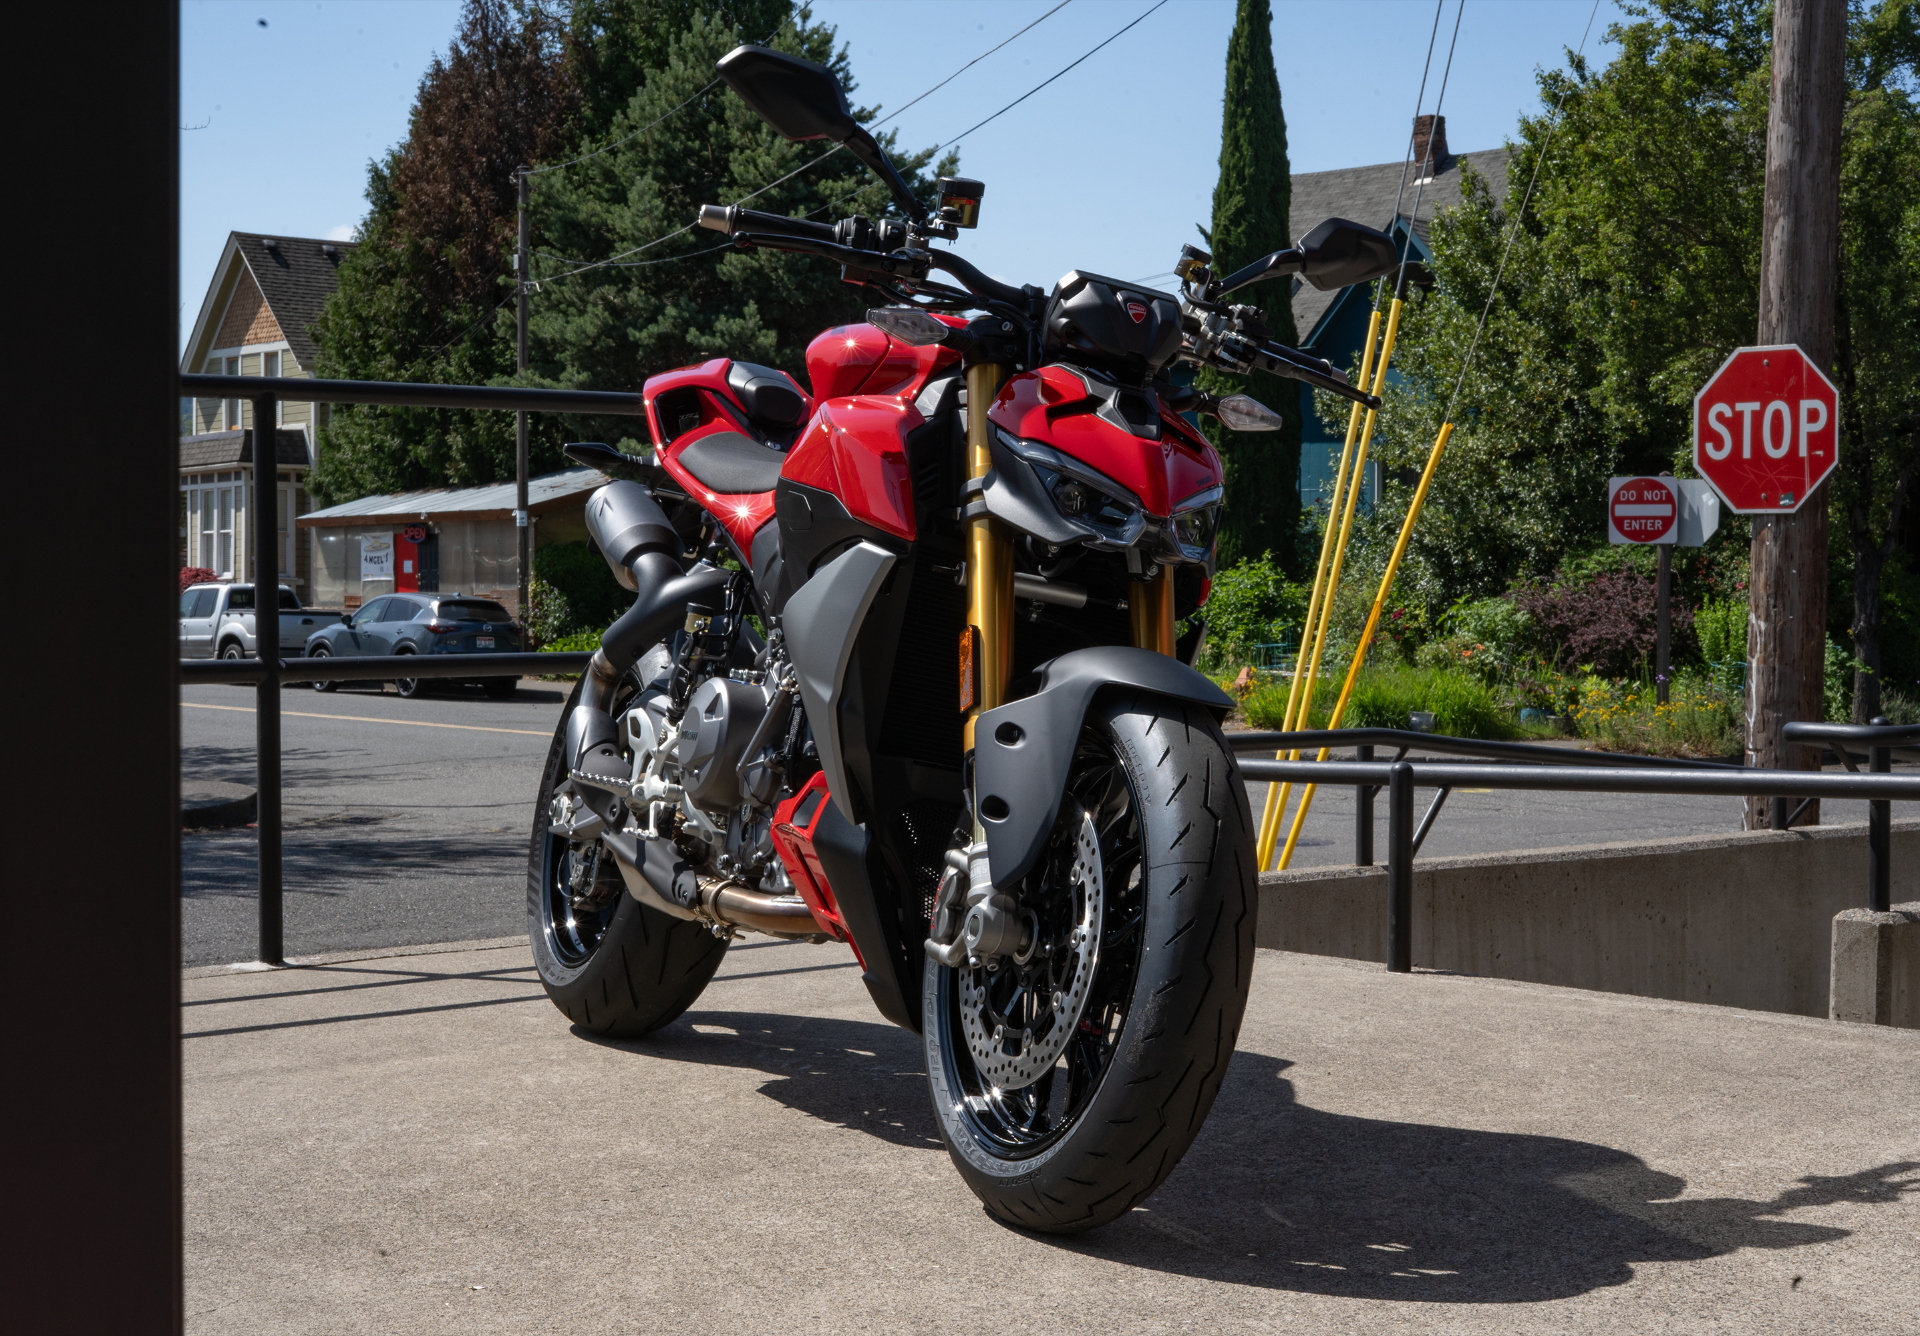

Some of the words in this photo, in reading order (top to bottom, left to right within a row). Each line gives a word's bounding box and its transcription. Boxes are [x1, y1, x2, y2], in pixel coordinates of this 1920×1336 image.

[1705, 399, 1828, 461] STOP
[1620, 490, 1637, 501] DO
[1644, 490, 1668, 501] NOT
[1624, 519, 1663, 531] ENTER
[403, 527, 426, 539] OPEN
[363, 552, 389, 565] ANGEL'S
